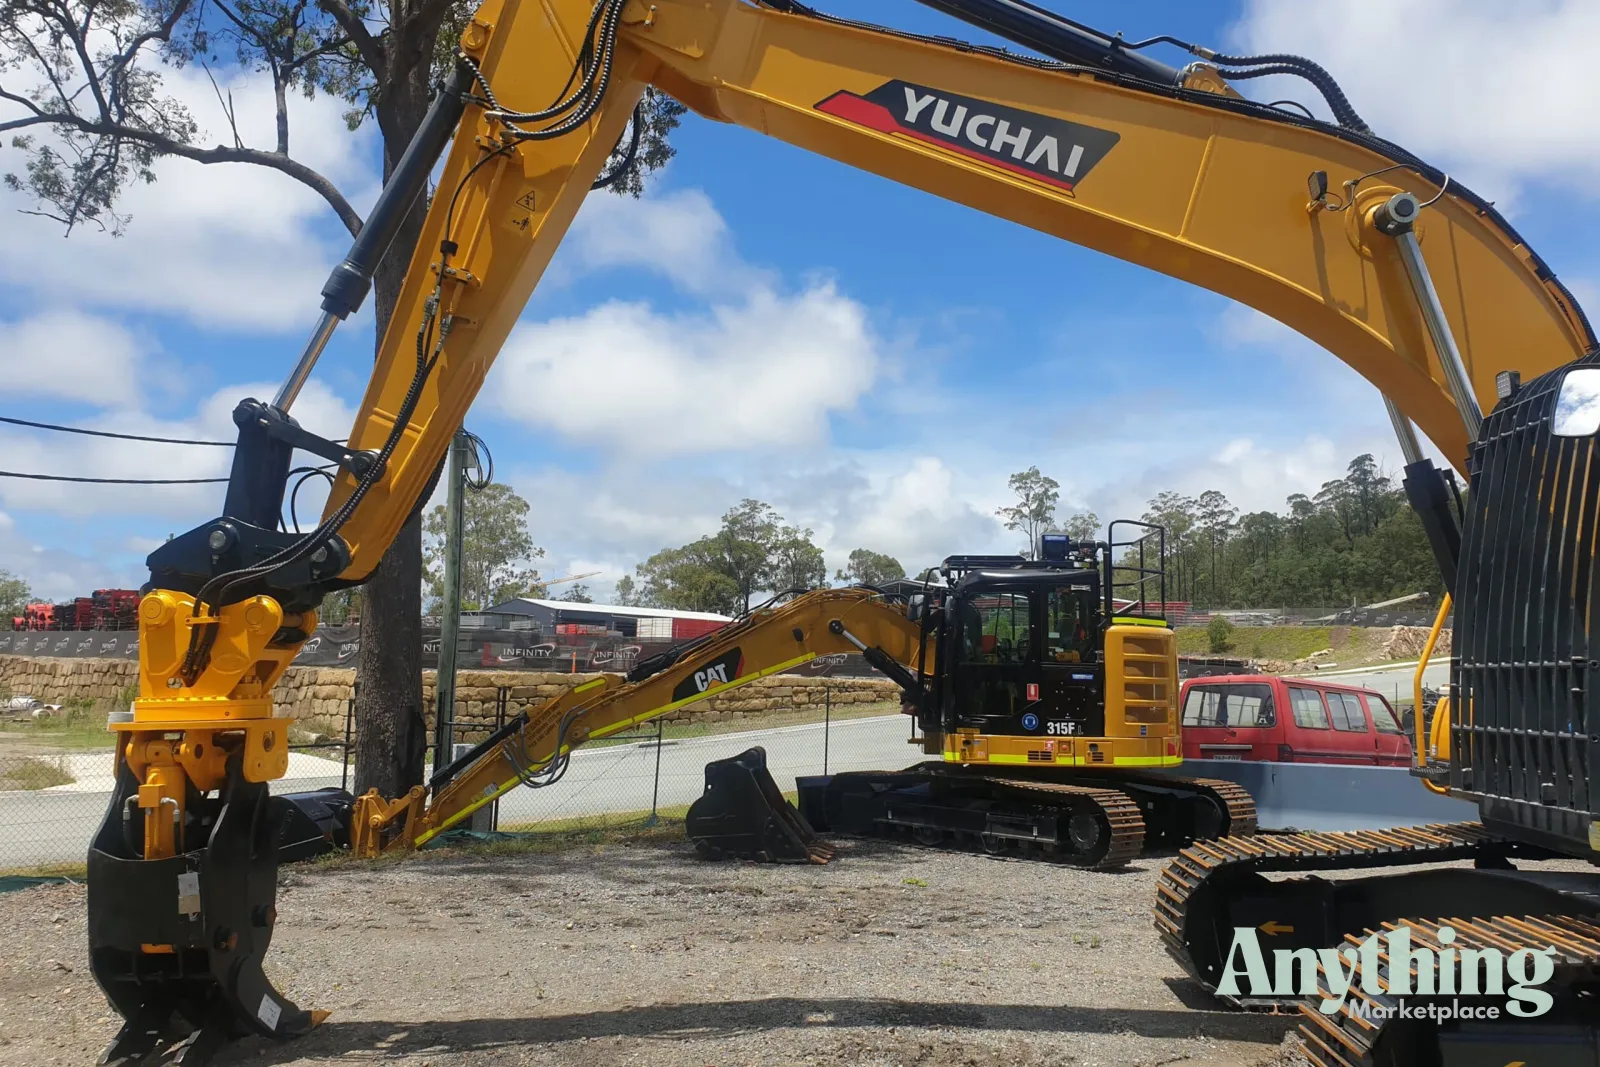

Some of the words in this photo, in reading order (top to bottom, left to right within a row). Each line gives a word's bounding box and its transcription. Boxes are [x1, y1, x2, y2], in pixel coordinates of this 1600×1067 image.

[902, 86, 1085, 178] YUCHAI
[341, 643, 360, 651] INFINI
[503, 648, 551, 657] INFINITY
[596, 651, 638, 659] INFINITY
[694, 663, 728, 692] CAT
[1046, 721, 1076, 735] 315F
